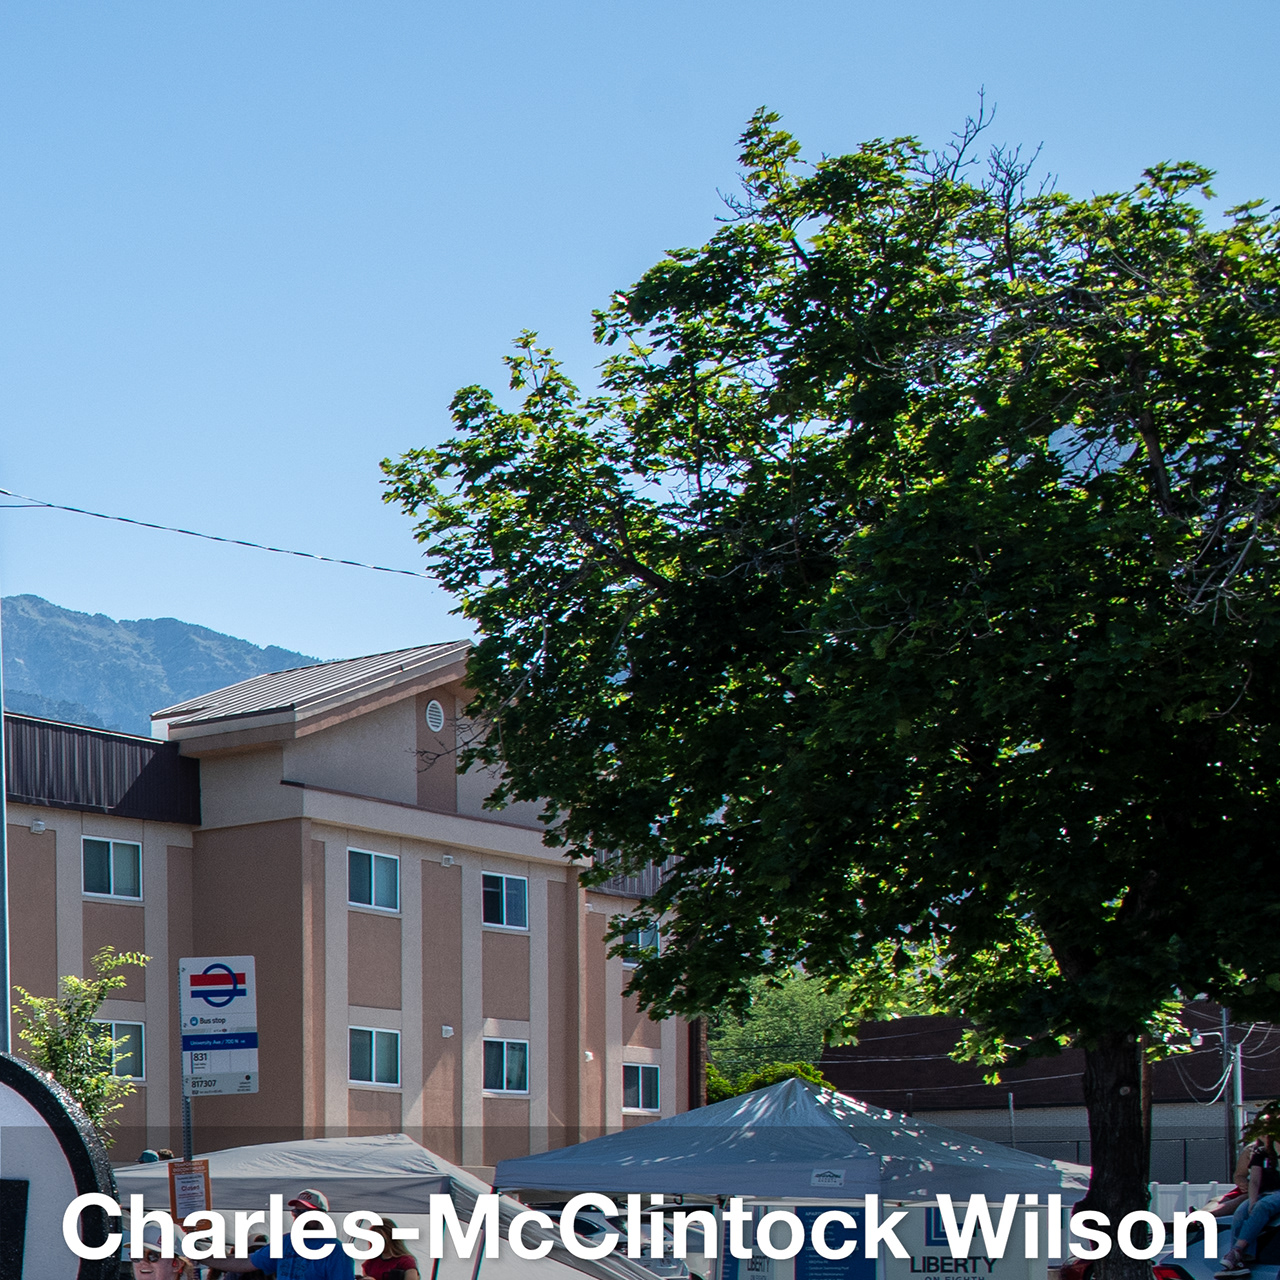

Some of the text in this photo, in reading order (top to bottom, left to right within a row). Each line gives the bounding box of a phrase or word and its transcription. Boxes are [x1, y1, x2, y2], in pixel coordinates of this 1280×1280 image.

[200, 1016, 227, 1025] Bus stop
[193, 1052, 208, 1062] 831
[191, 1079, 217, 1089] 817307
[910, 1255, 998, 1274] LIBERTY
